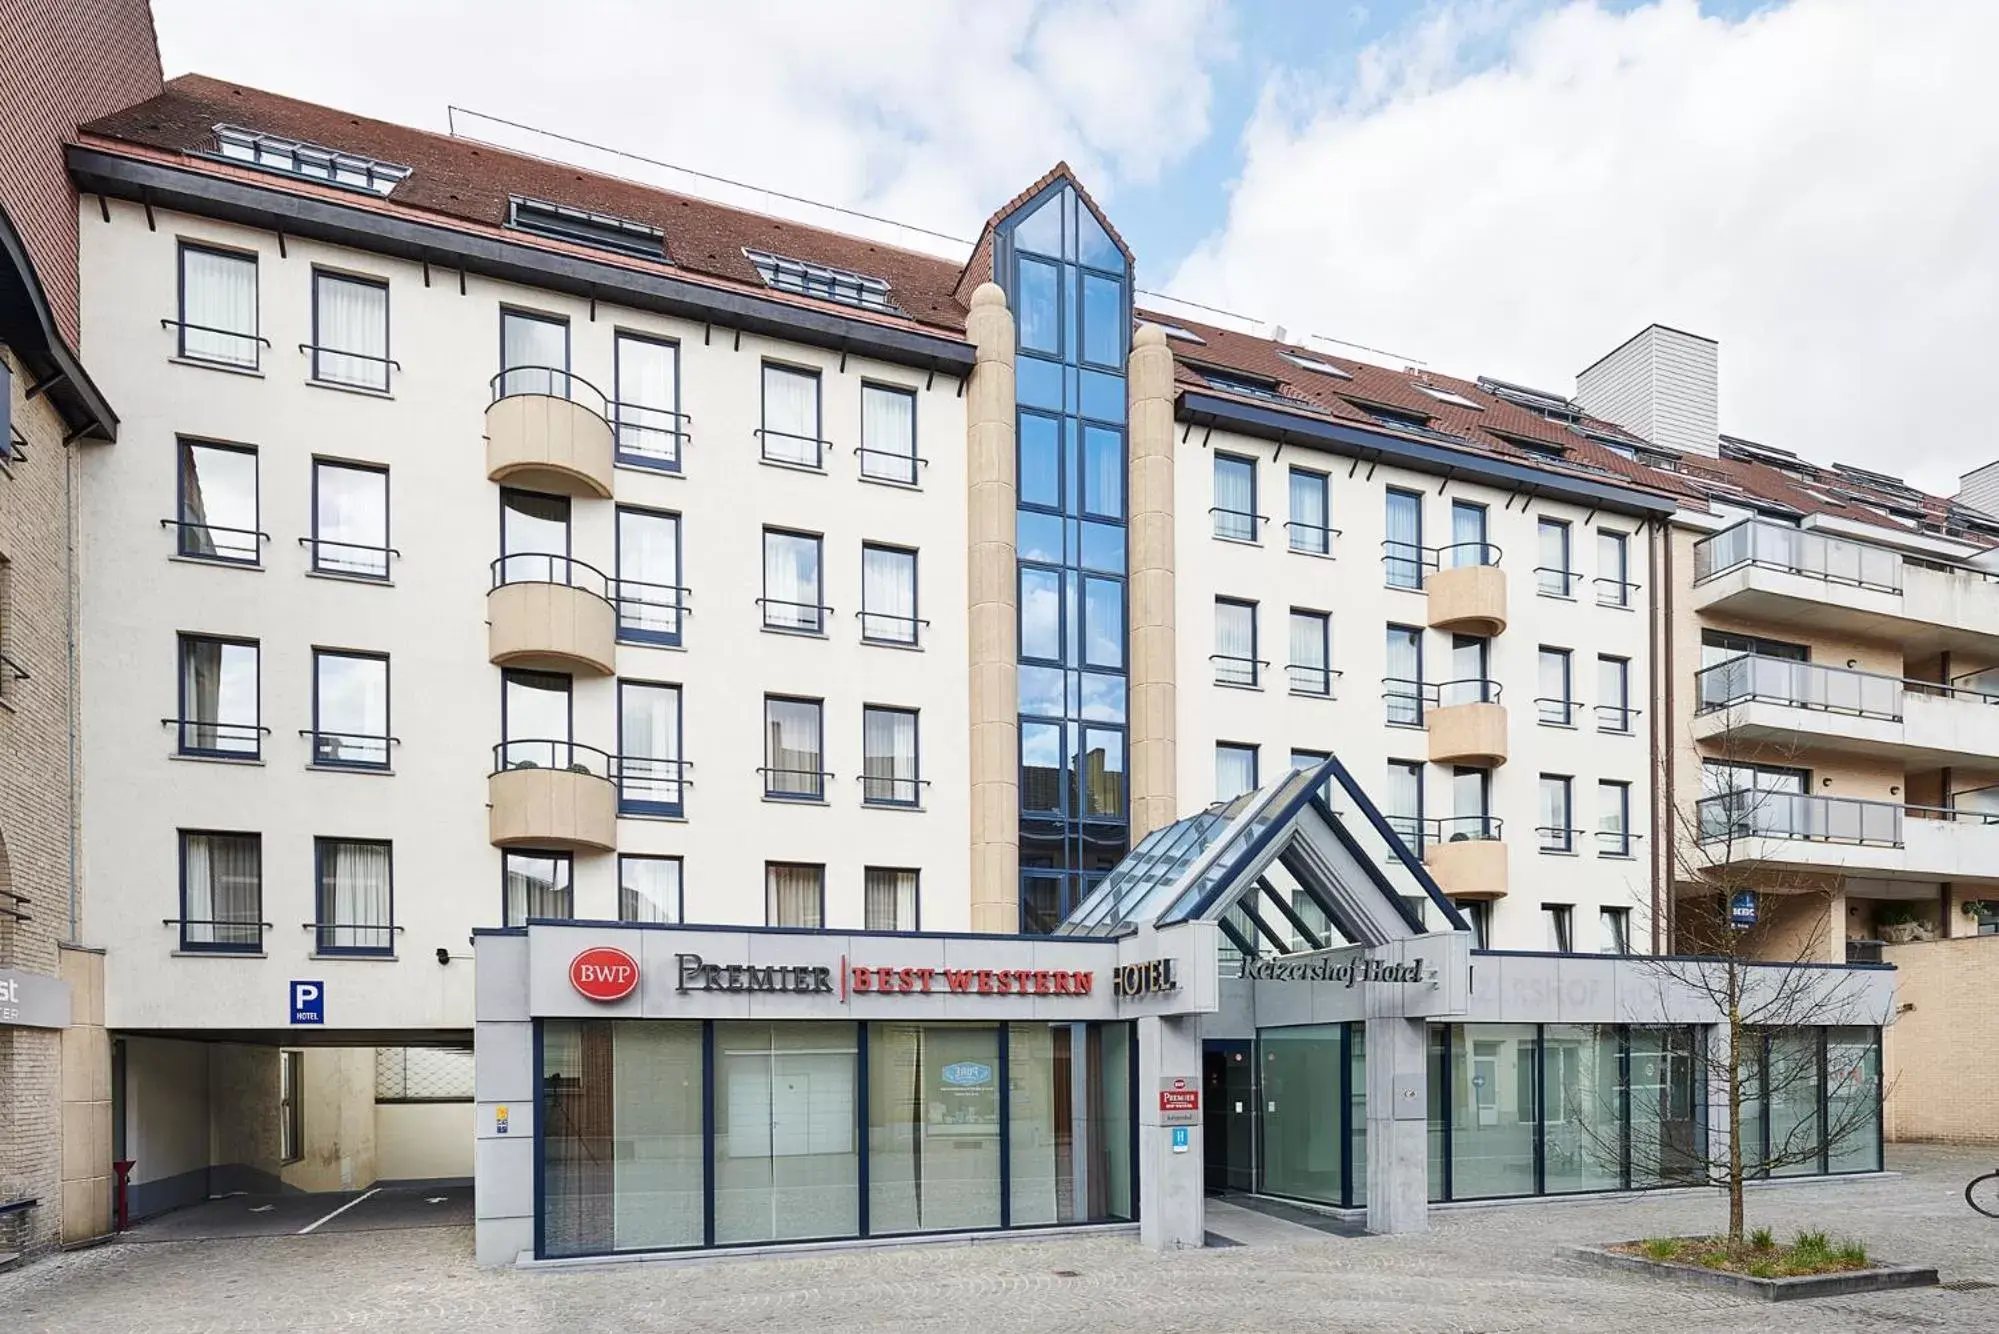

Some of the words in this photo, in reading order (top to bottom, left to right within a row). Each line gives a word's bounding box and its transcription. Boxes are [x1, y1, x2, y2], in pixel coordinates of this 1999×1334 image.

[580, 964, 631, 983] BWP
[674, 953, 833, 994] PREMIER
[852, 966, 934, 993] BEST
[945, 968, 1093, 994] WESTERN
[1112, 957, 1178, 996] HOTEL
[1363, 957, 1424, 983] Hotel
[296, 984, 318, 1009] P
[296, 1012, 319, 1020] HOTEL
